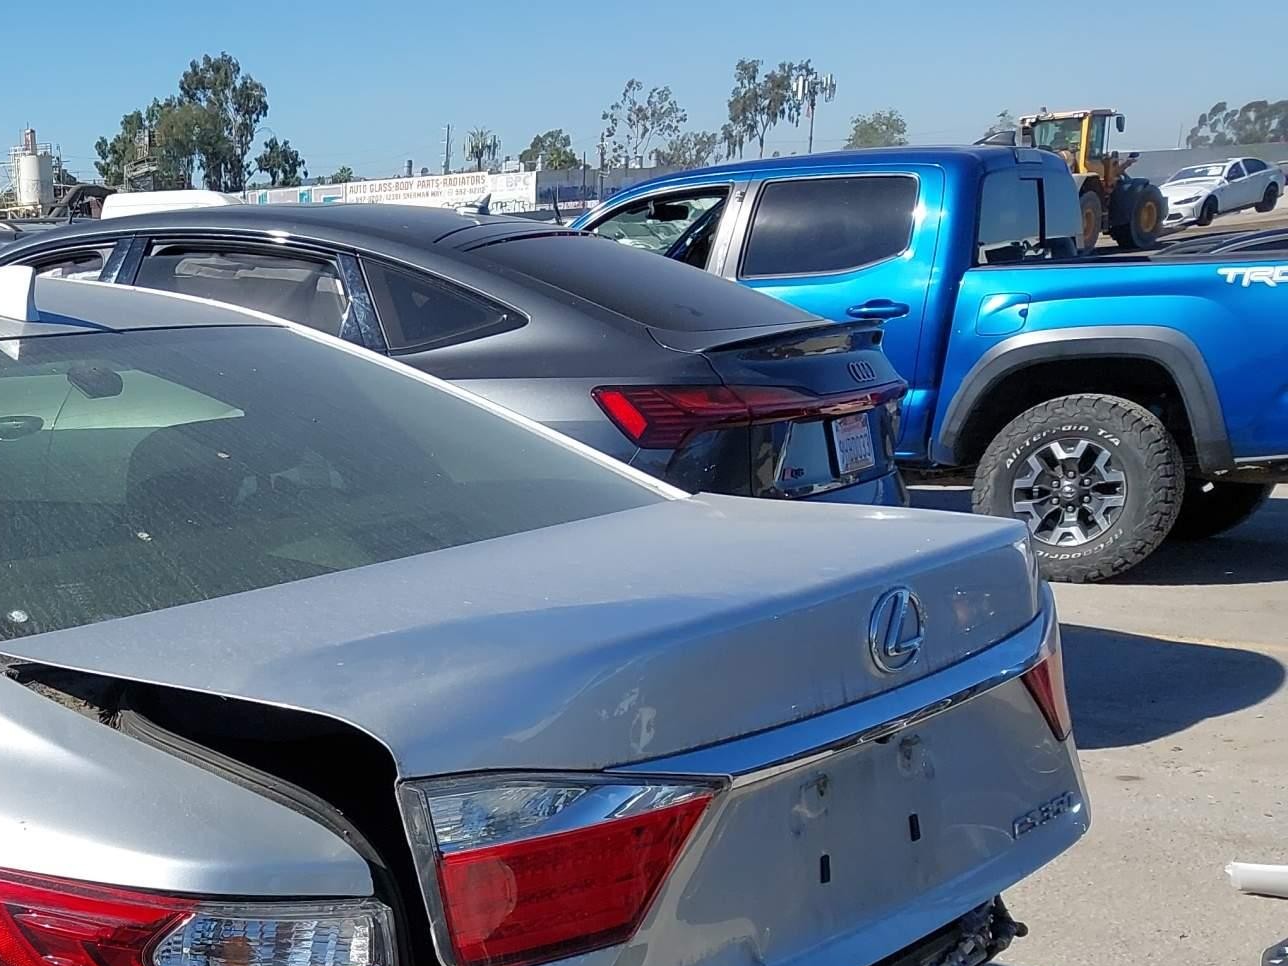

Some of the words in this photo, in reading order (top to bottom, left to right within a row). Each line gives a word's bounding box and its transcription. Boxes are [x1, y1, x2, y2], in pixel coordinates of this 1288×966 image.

[350, 184, 367, 194] AUTO
[369, 182, 392, 193] GLASS
[394, 180, 414, 191] BODY
[417, 178, 440, 190] PARTS
[442, 175, 486, 188] RADIATORS
[1096, 427, 1121, 447] T/A
